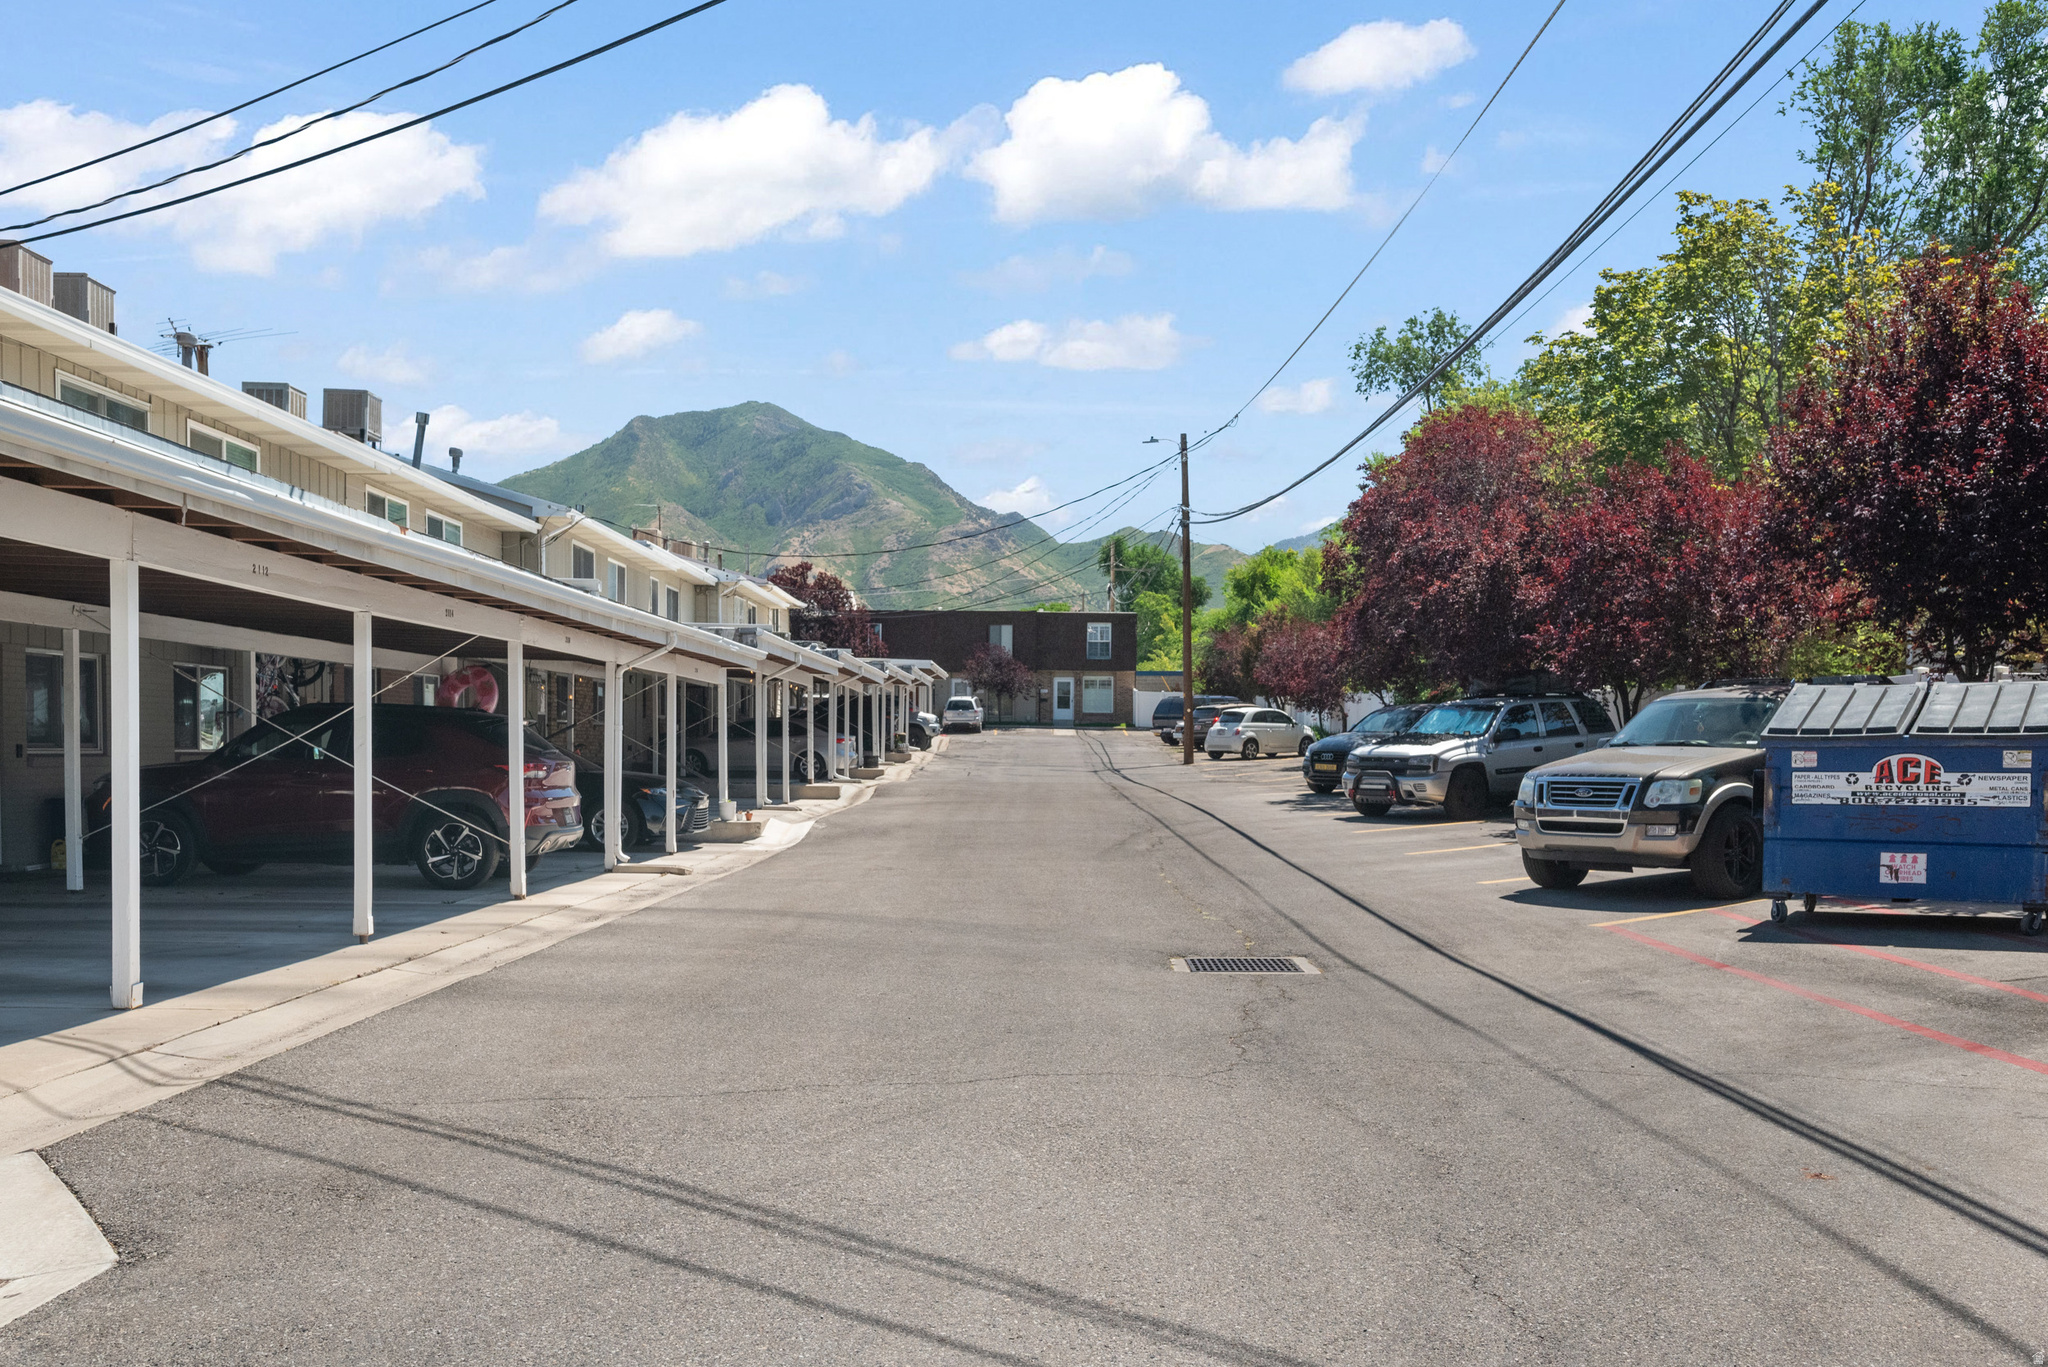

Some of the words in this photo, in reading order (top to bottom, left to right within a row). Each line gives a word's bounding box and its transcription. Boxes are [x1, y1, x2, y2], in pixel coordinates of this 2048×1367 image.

[252, 563, 269, 577] 2112
[1874, 757, 1942, 785] ACE
[1864, 784, 1952, 792] RECYCLING
